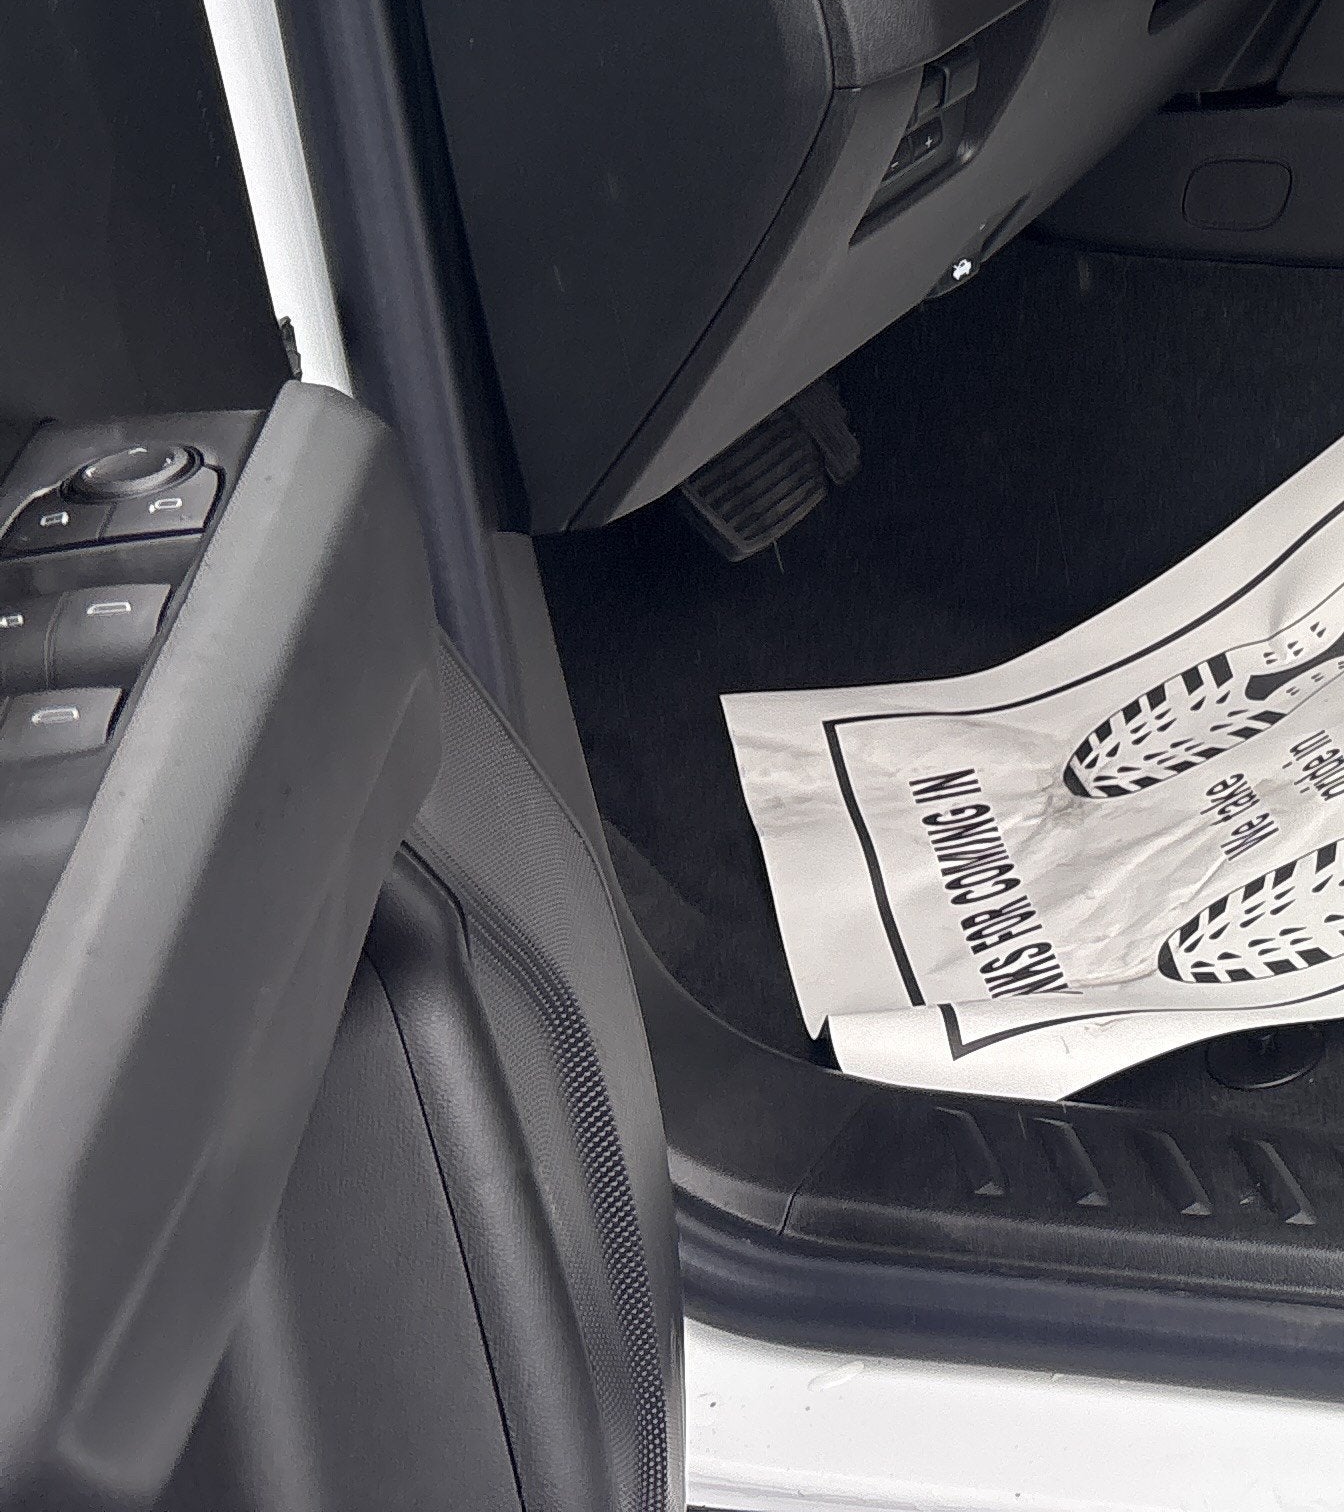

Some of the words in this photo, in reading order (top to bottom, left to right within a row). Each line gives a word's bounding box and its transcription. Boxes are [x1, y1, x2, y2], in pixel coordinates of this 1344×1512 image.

[1282, 730, 1333, 769] in
[909, 768, 982, 804] IN
[1200, 773, 1261, 826] take
[921, 803, 1022, 906] COMING
[1220, 813, 1280, 861] We
[961, 895, 1043, 955] FOR
